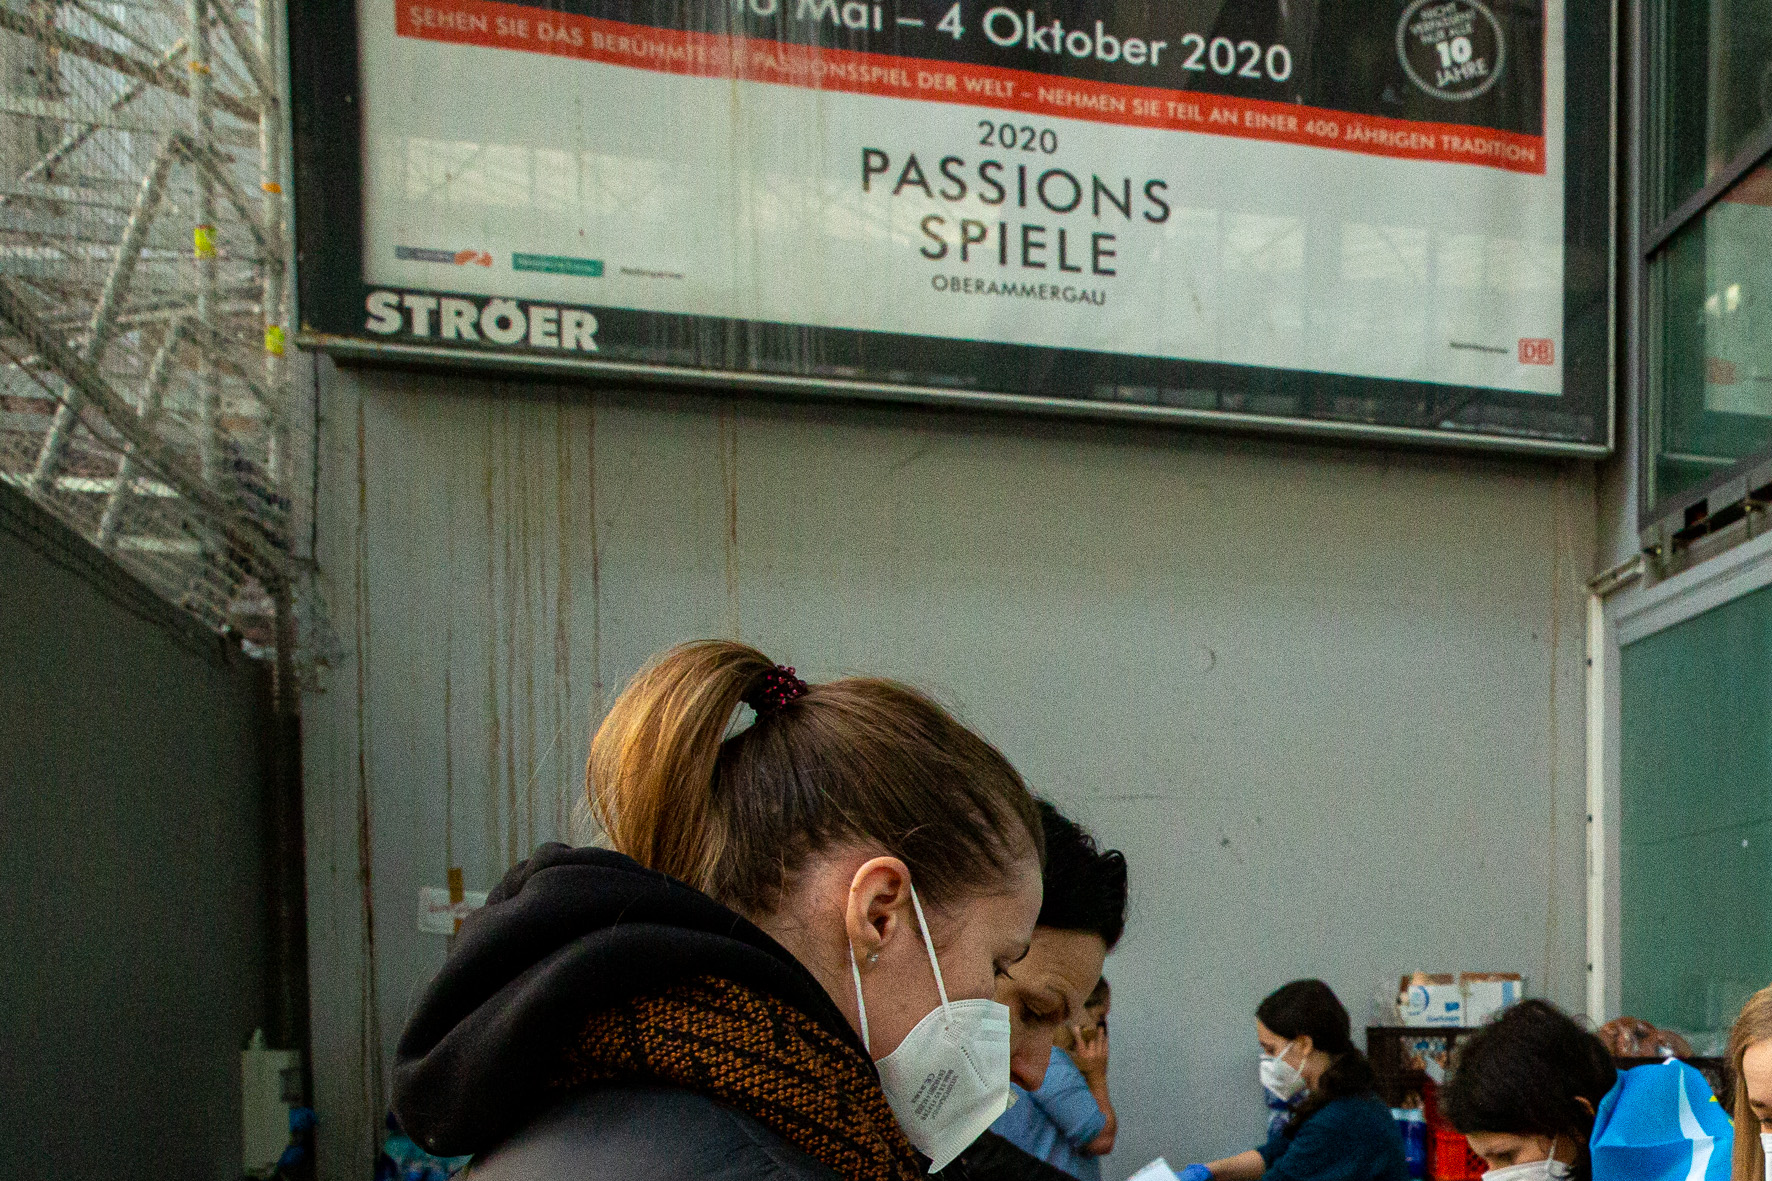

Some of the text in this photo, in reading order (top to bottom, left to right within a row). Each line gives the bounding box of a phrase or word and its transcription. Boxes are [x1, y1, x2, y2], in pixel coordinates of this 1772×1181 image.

[937, 4, 966, 40] 4
[982, 7, 1168, 66] Oktober
[1181, 34, 1294, 82] 2020
[1436, 36, 1473, 68] 10
[1436, 57, 1489, 88] JAHRE
[409, 6, 488, 33] SEHEN
[495, 16, 529, 39] SIE
[537, 22, 585, 47] DAS
[918, 68, 957, 93] DER
[963, 76, 1016, 99] WELT
[1038, 86, 1126, 114] NEHMEN
[1131, 97, 1161, 118] SIE
[1166, 101, 1202, 122] TEIL
[1207, 107, 1239, 126] AN
[1244, 111, 1299, 132] EINER
[1304, 119, 1339, 139] 400
[1346, 121, 1436, 149] JÄHRIGEN
[1441, 134, 1536, 162] TRADITION
[978, 120, 1058, 154] 2020
[862, 147, 1171, 224] PASSIONS
[920, 214, 1117, 277] SPIELE
[365, 290, 599, 352] STRÖER
[931, 274, 1107, 307] OBERAMMERGAU
